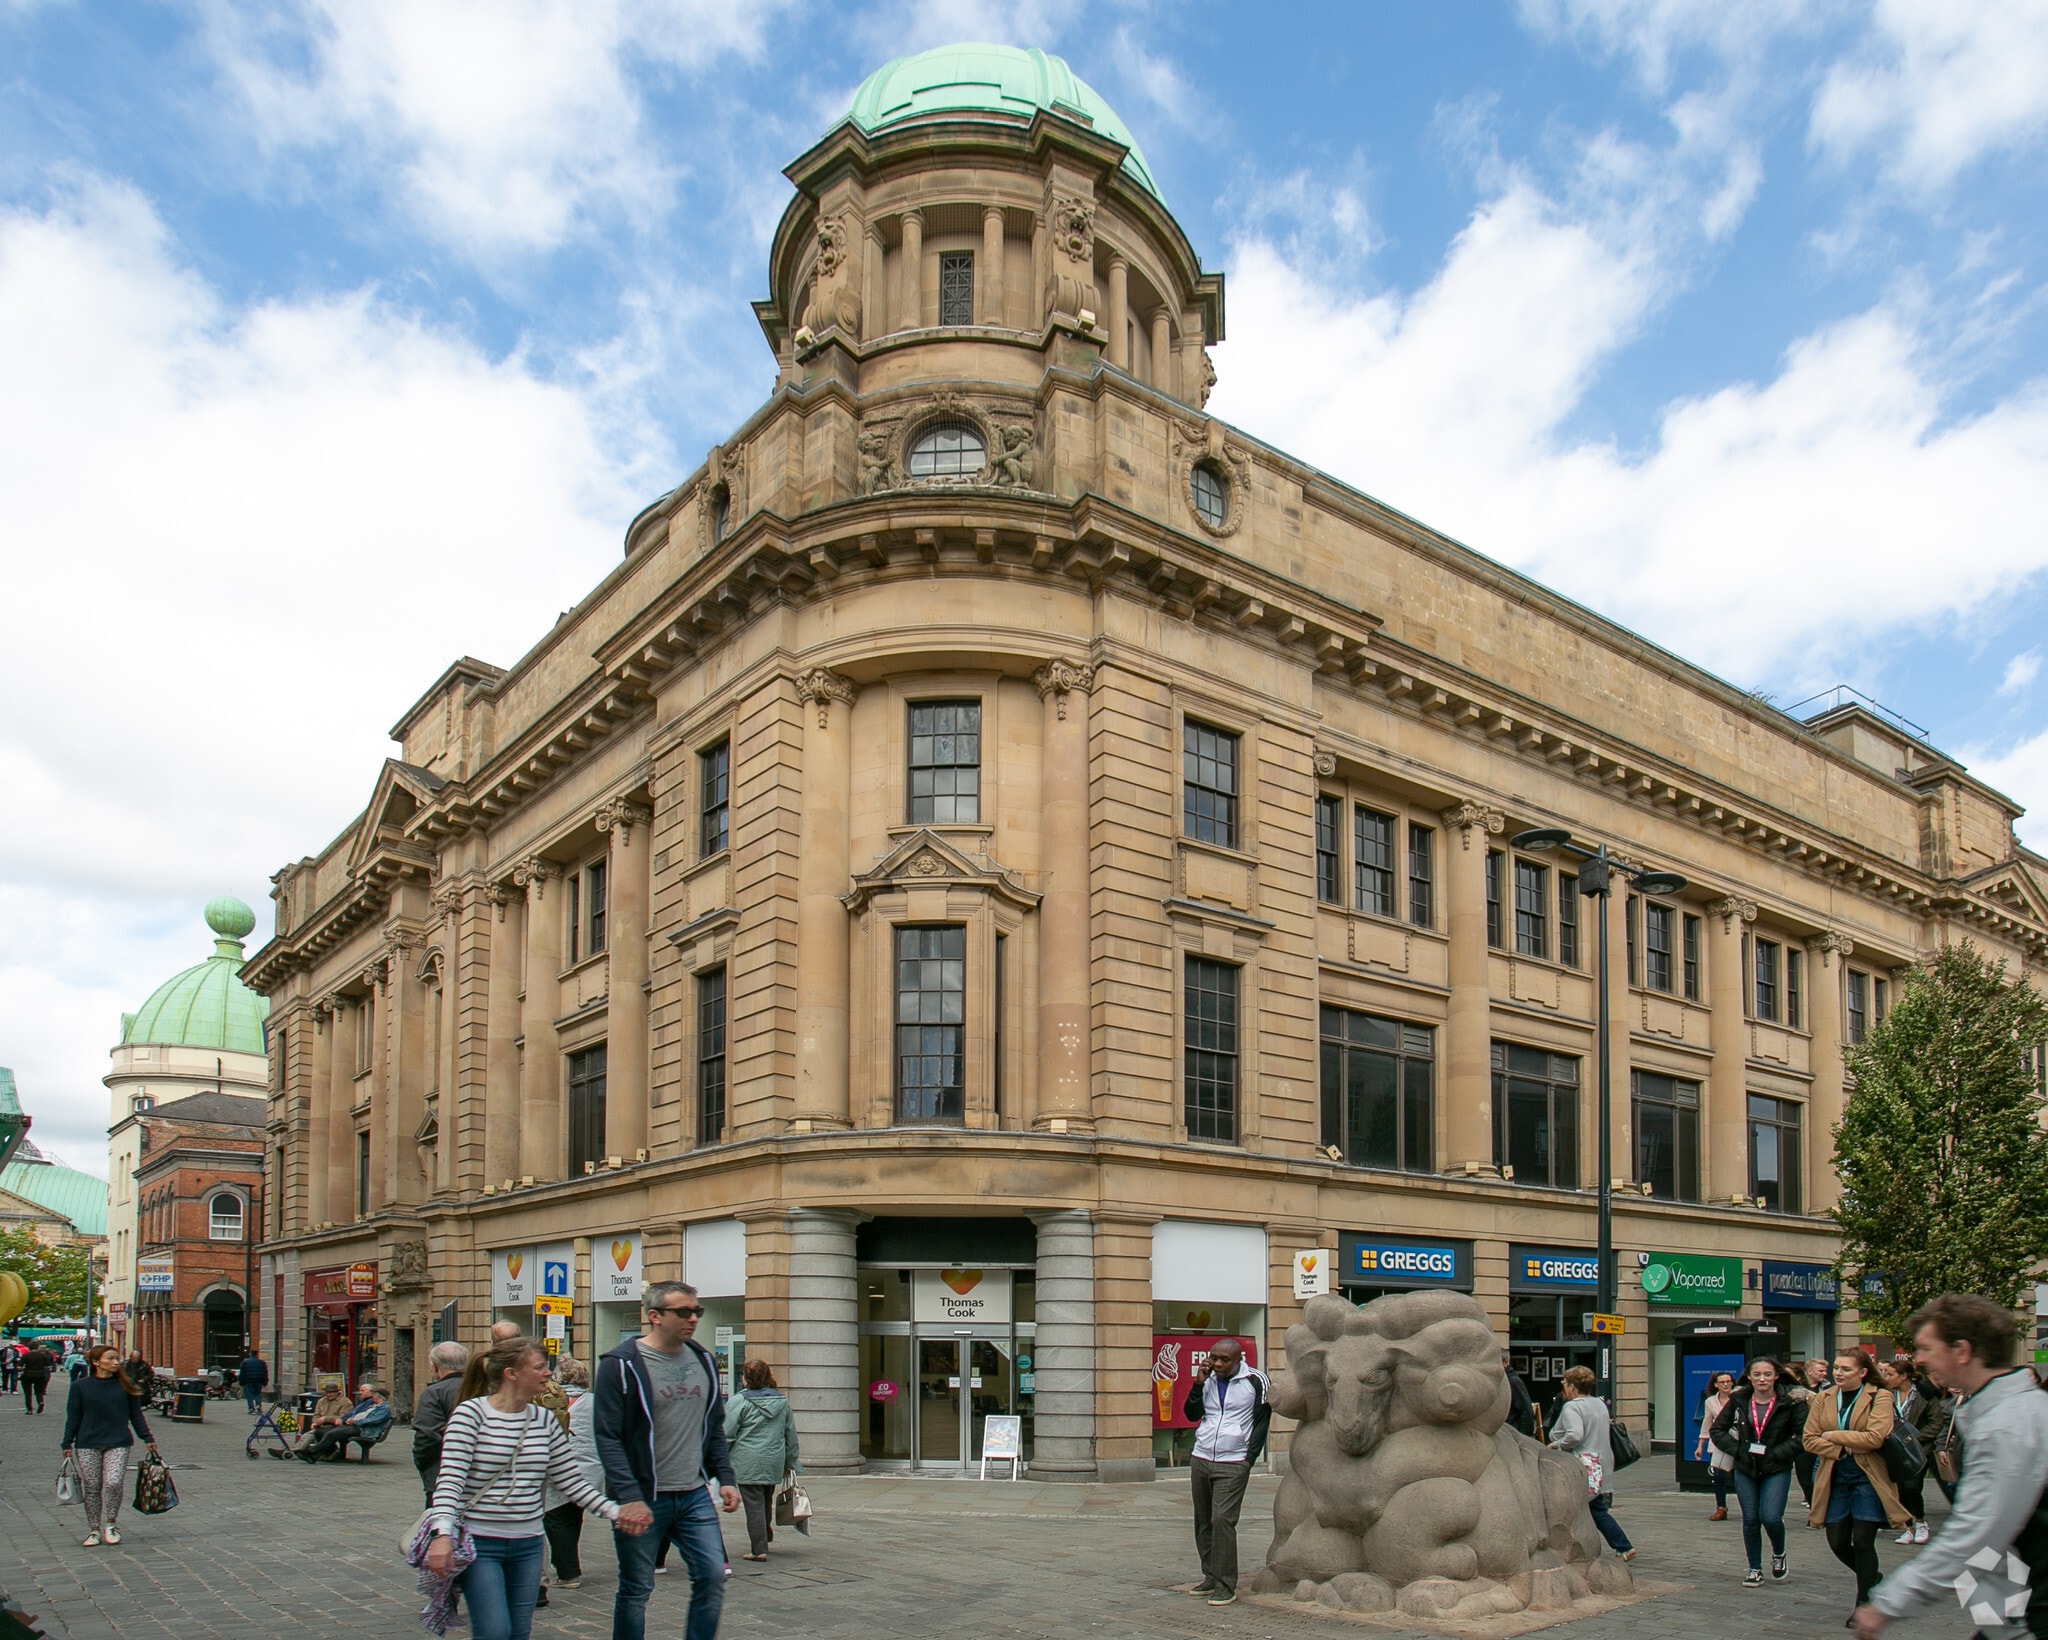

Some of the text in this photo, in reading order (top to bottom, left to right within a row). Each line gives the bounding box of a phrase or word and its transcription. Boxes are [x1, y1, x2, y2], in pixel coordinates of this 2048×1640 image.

[1380, 1251, 1452, 1272] GREGGS
[1542, 1261, 1598, 1279] GREGGS
[611, 1275, 632, 1285] Thomas
[1671, 1266, 1725, 1289] Vaporized
[506, 1283, 523, 1292] Thomas
[614, 1286, 628, 1296] Cook
[508, 1293, 519, 1301] Cook
[940, 1297, 984, 1307] Thomas
[947, 1308, 975, 1318] Cook
[659, 1382, 702, 1399] USA
